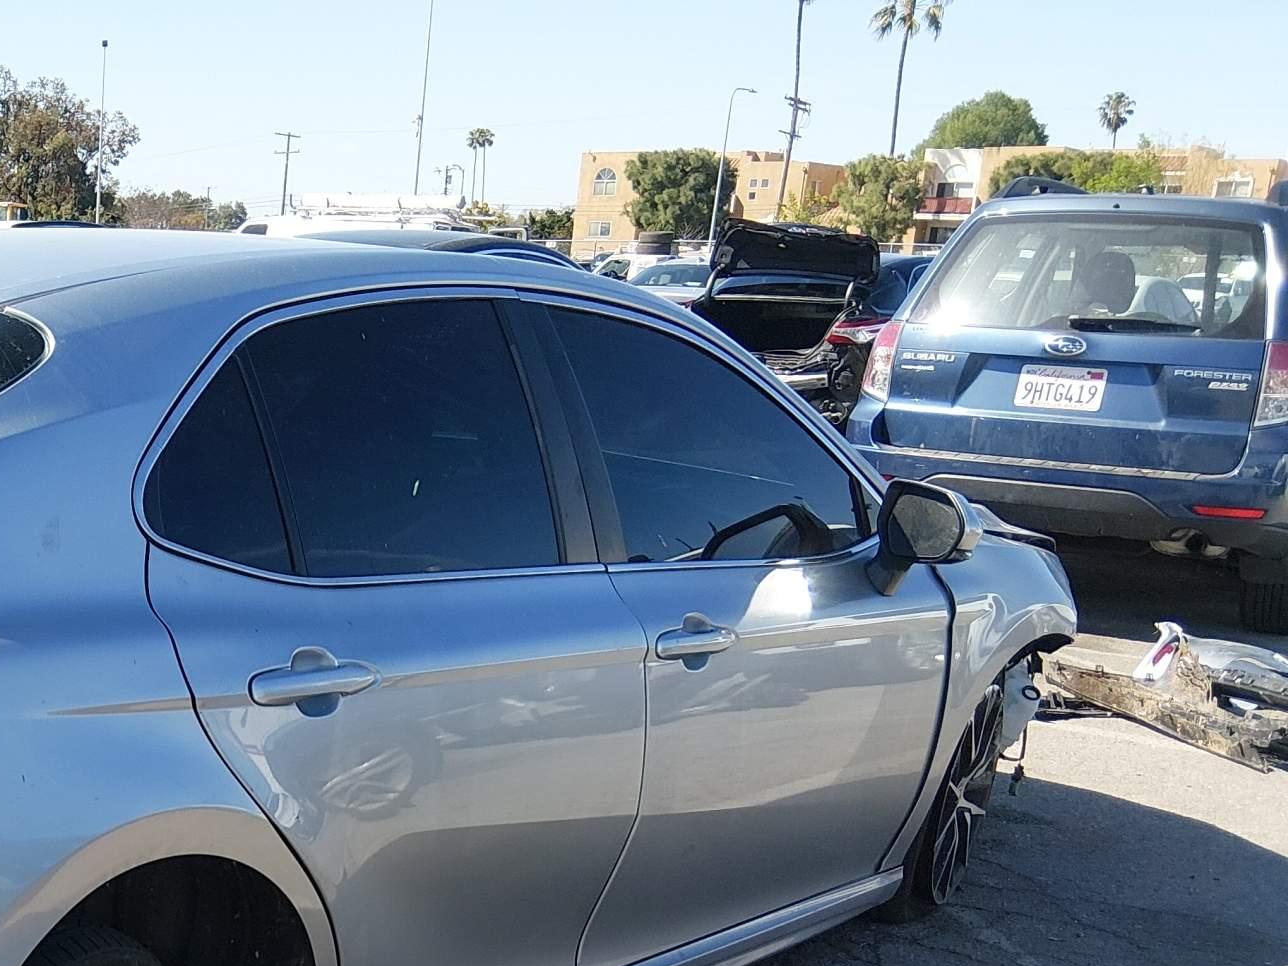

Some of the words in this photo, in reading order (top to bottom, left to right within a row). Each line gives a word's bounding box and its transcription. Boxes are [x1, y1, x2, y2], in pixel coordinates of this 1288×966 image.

[902, 352, 955, 362] SUBARU
[1037, 367, 1091, 381] California
[1174, 369, 1253, 381] FORESTER
[1021, 381, 1098, 404] 9HTG419
